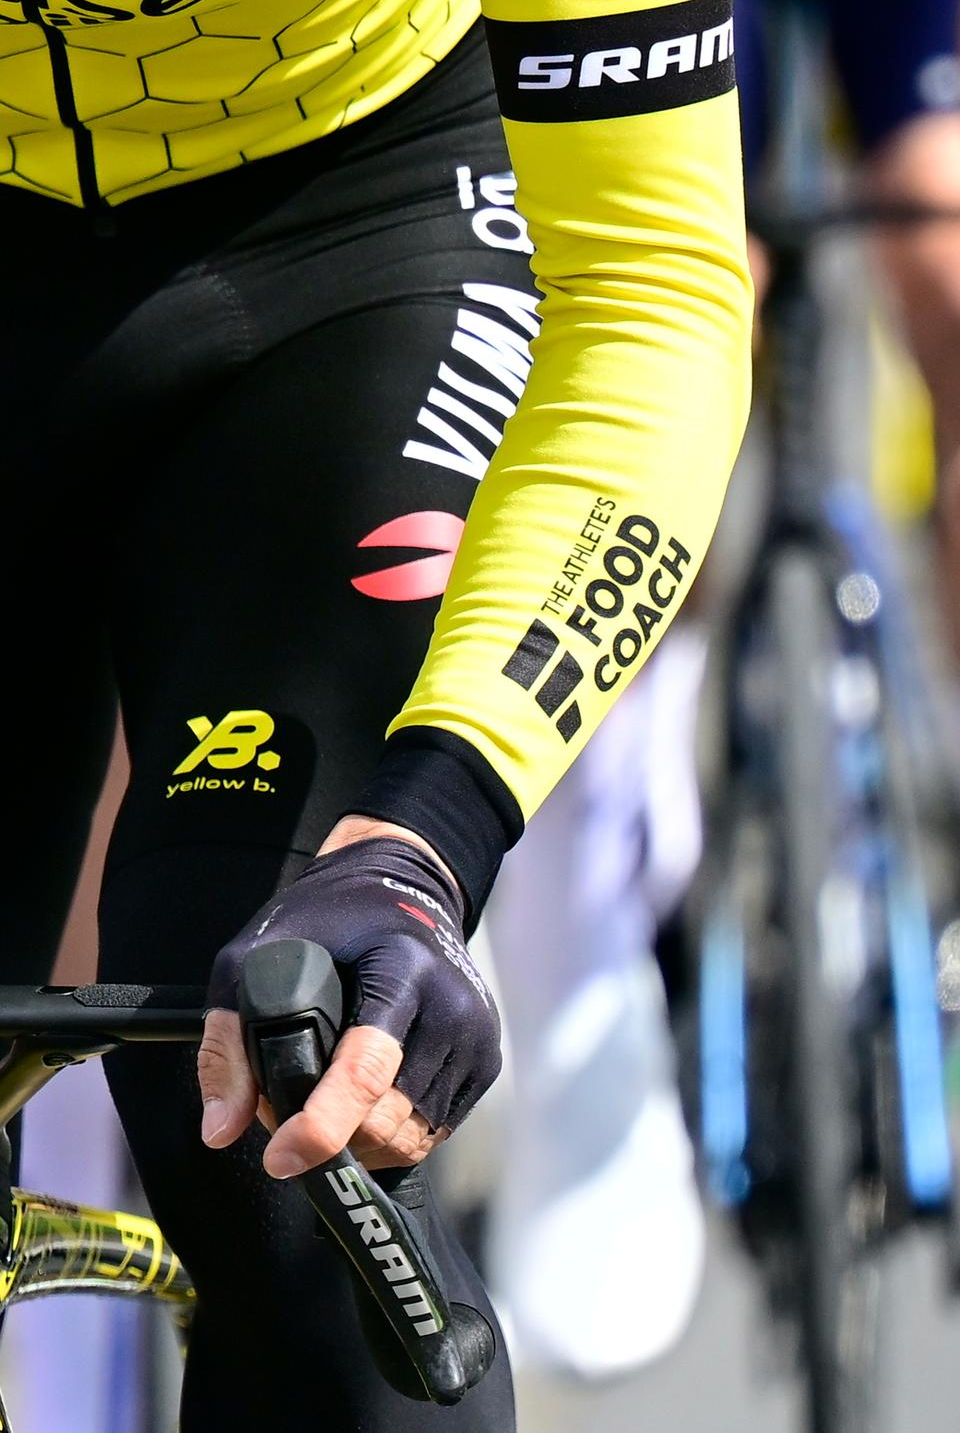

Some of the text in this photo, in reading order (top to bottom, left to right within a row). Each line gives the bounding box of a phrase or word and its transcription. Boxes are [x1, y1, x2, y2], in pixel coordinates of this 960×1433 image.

[518, 17, 734, 89] SRAM
[402, 283, 543, 481] VISMA
[541, 497, 616, 615] THE ATHLETE'S
[565, 514, 660, 647] FOOD
[594, 537, 691, 692] COACH
[166, 777, 275, 798] yellow b.
[325, 1166, 443, 1337] SRAM
